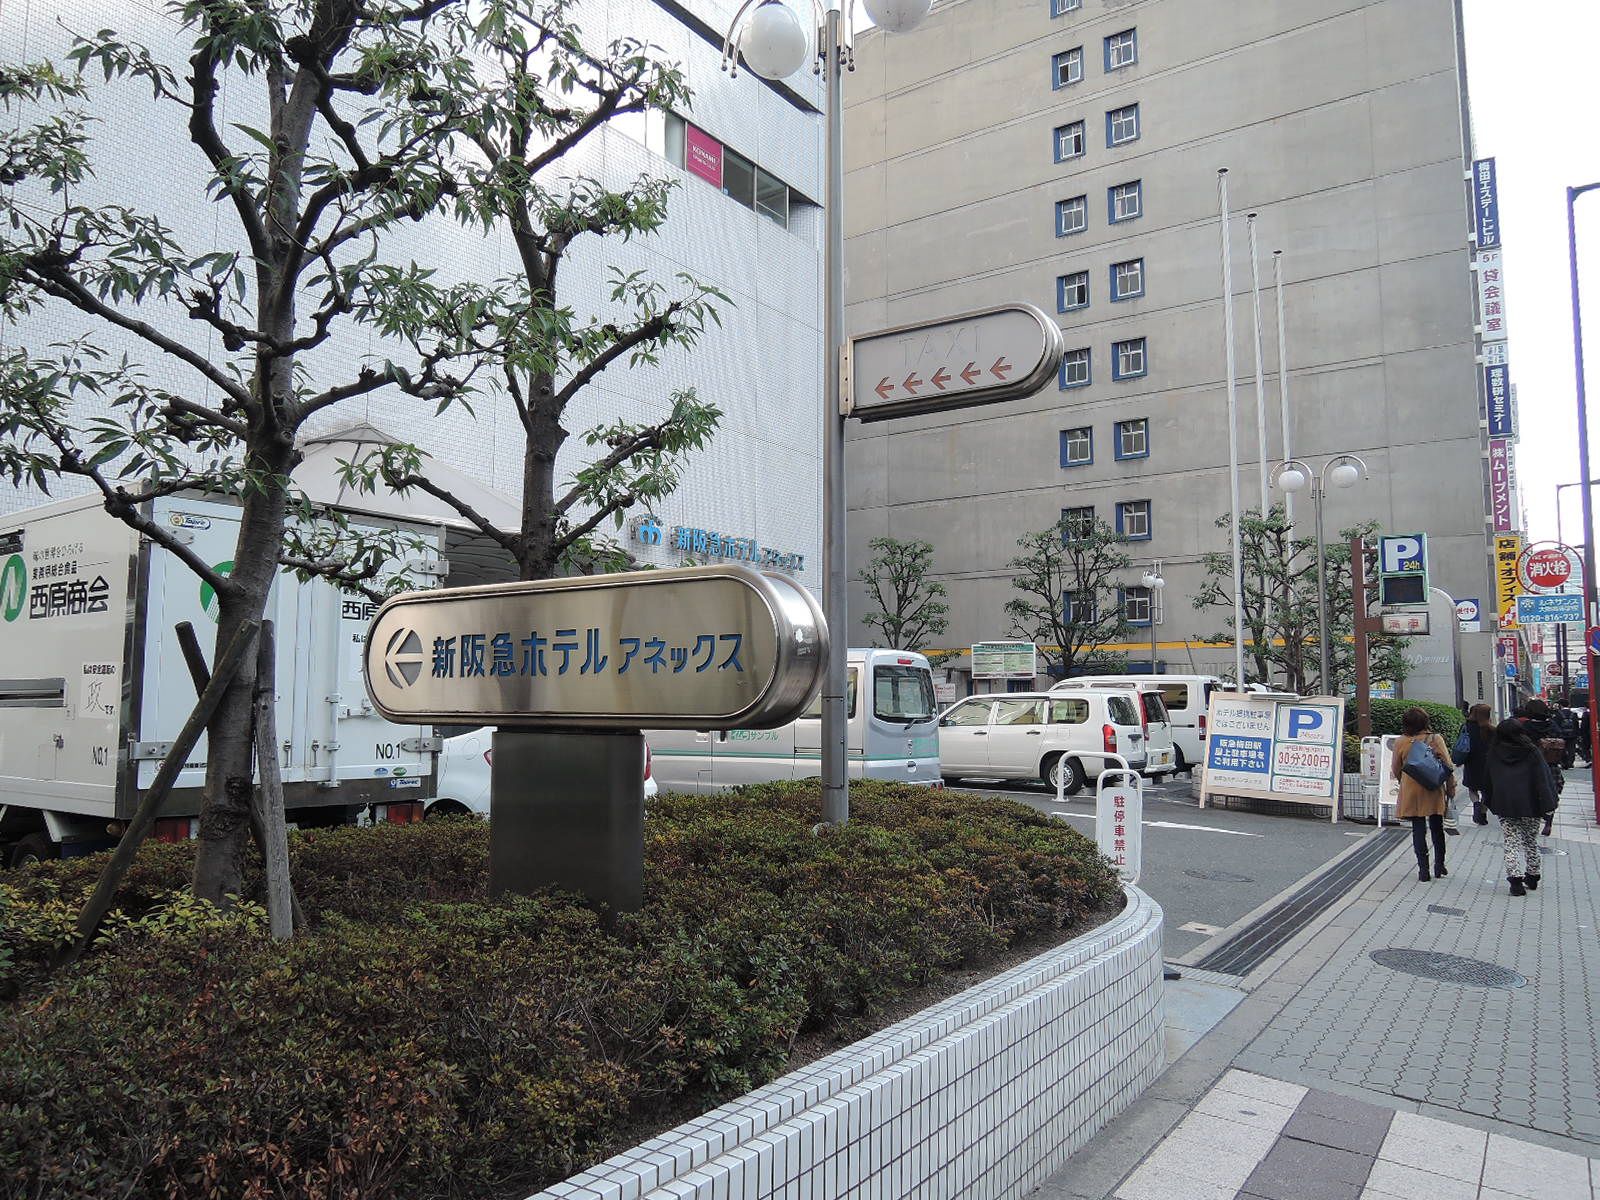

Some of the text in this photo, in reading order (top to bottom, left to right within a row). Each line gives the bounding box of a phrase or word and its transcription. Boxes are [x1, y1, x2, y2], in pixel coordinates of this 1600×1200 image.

[676, 527, 760, 563] 新阪急ホテル
[1384, 537, 1421, 572] P 24h
[1529, 560, 1568, 578] 消火栓
[29, 575, 109, 619] 西原商会
[431, 627, 744, 679] 新阪急ホテル アネックス
[1288, 709, 1323, 739] P
[376, 743, 400, 760] NO.1
[1214, 757, 1265, 768] ご利用下さい
[1278, 751, 1330, 768] 30分200円
[1113, 796, 1126, 866] 駐停車禁止
